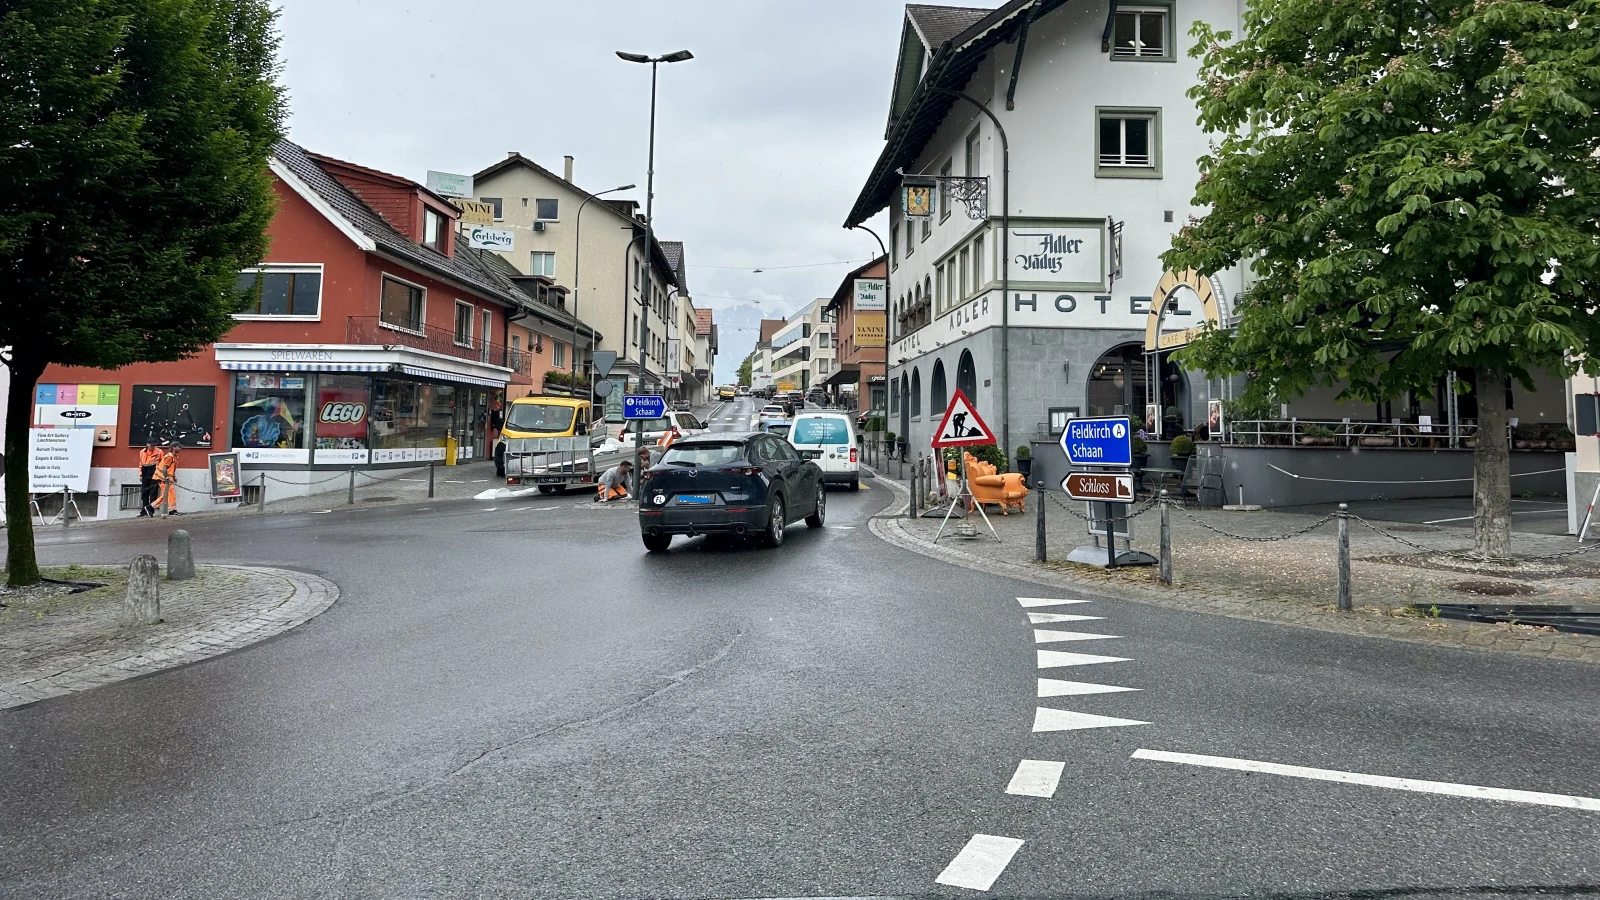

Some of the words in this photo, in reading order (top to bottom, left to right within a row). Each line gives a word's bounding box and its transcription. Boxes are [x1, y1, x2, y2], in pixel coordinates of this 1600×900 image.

[472, 229, 513, 246] Carlsberg
[1013, 231, 1084, 256] Adler
[1015, 254, 1063, 273] Vaduz
[1015, 293, 1191, 316] HOTEL
[857, 326, 884, 334] VANINI
[899, 333, 921, 354] HOTEL
[949, 296, 989, 331] ADLER
[271, 350, 333, 360] SPIELWAREN
[635, 397, 661, 407] Feldkirch
[321, 402, 366, 423] LEGO
[1072, 423, 1110, 438] Feldkirch
[1073, 443, 1102, 457] Schaan
[1079, 478, 1109, 493] Schloss
